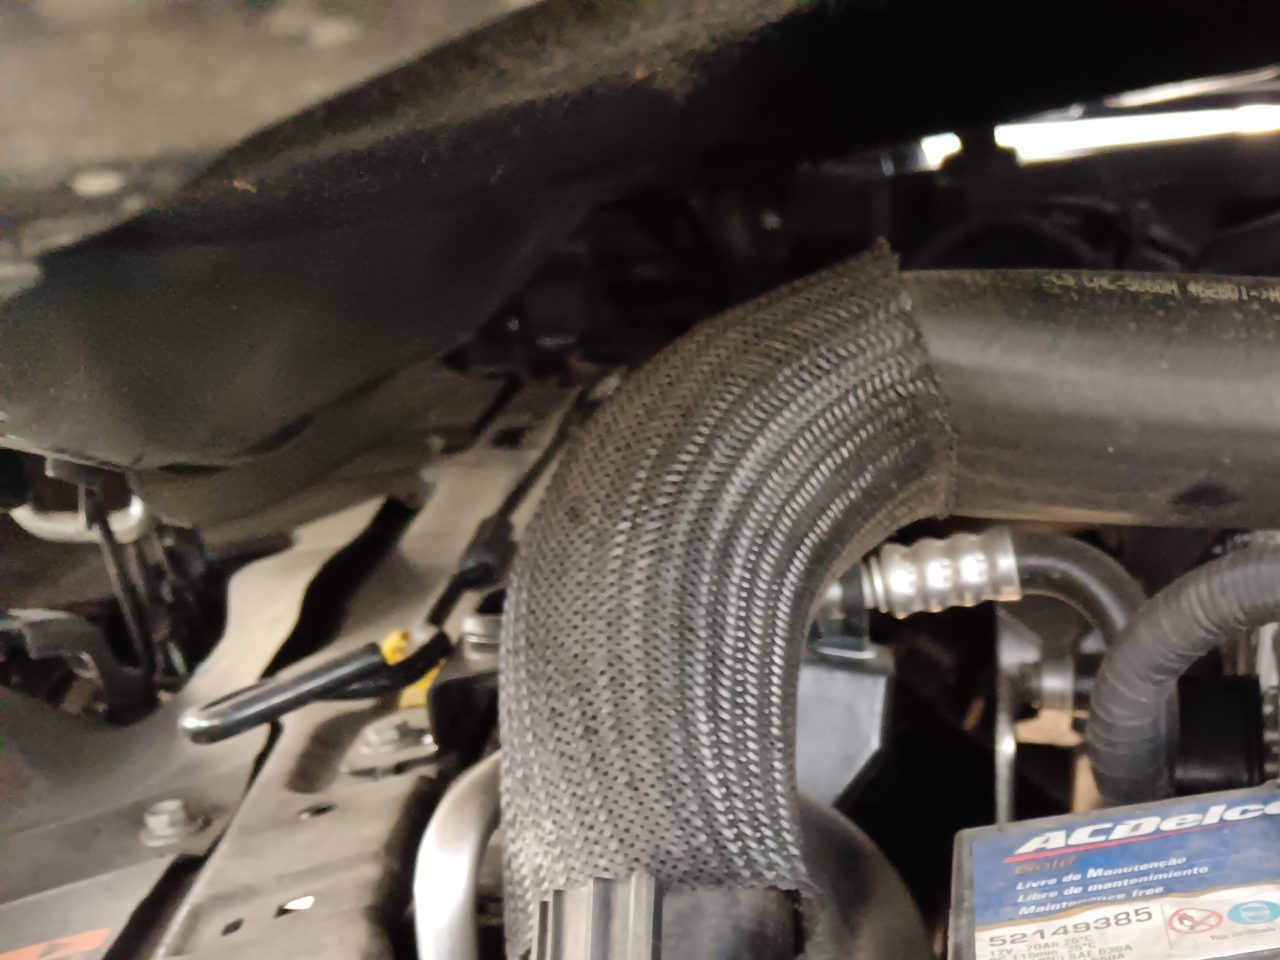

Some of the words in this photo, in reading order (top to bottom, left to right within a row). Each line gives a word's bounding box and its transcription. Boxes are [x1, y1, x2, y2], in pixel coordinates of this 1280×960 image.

[1016, 874, 1057, 891] Livre
[1061, 871, 1082, 883] de
[1086, 855, 1188, 879] Manutenção
[1017, 887, 1059, 903] Libre
[1063, 883, 1084, 896] de
[1087, 865, 1210, 892] mantenimiento
[1018, 891, 1126, 917] Maintenance
[1130, 885, 1165, 899] free
[988, 906, 1154, 947] 52149385
